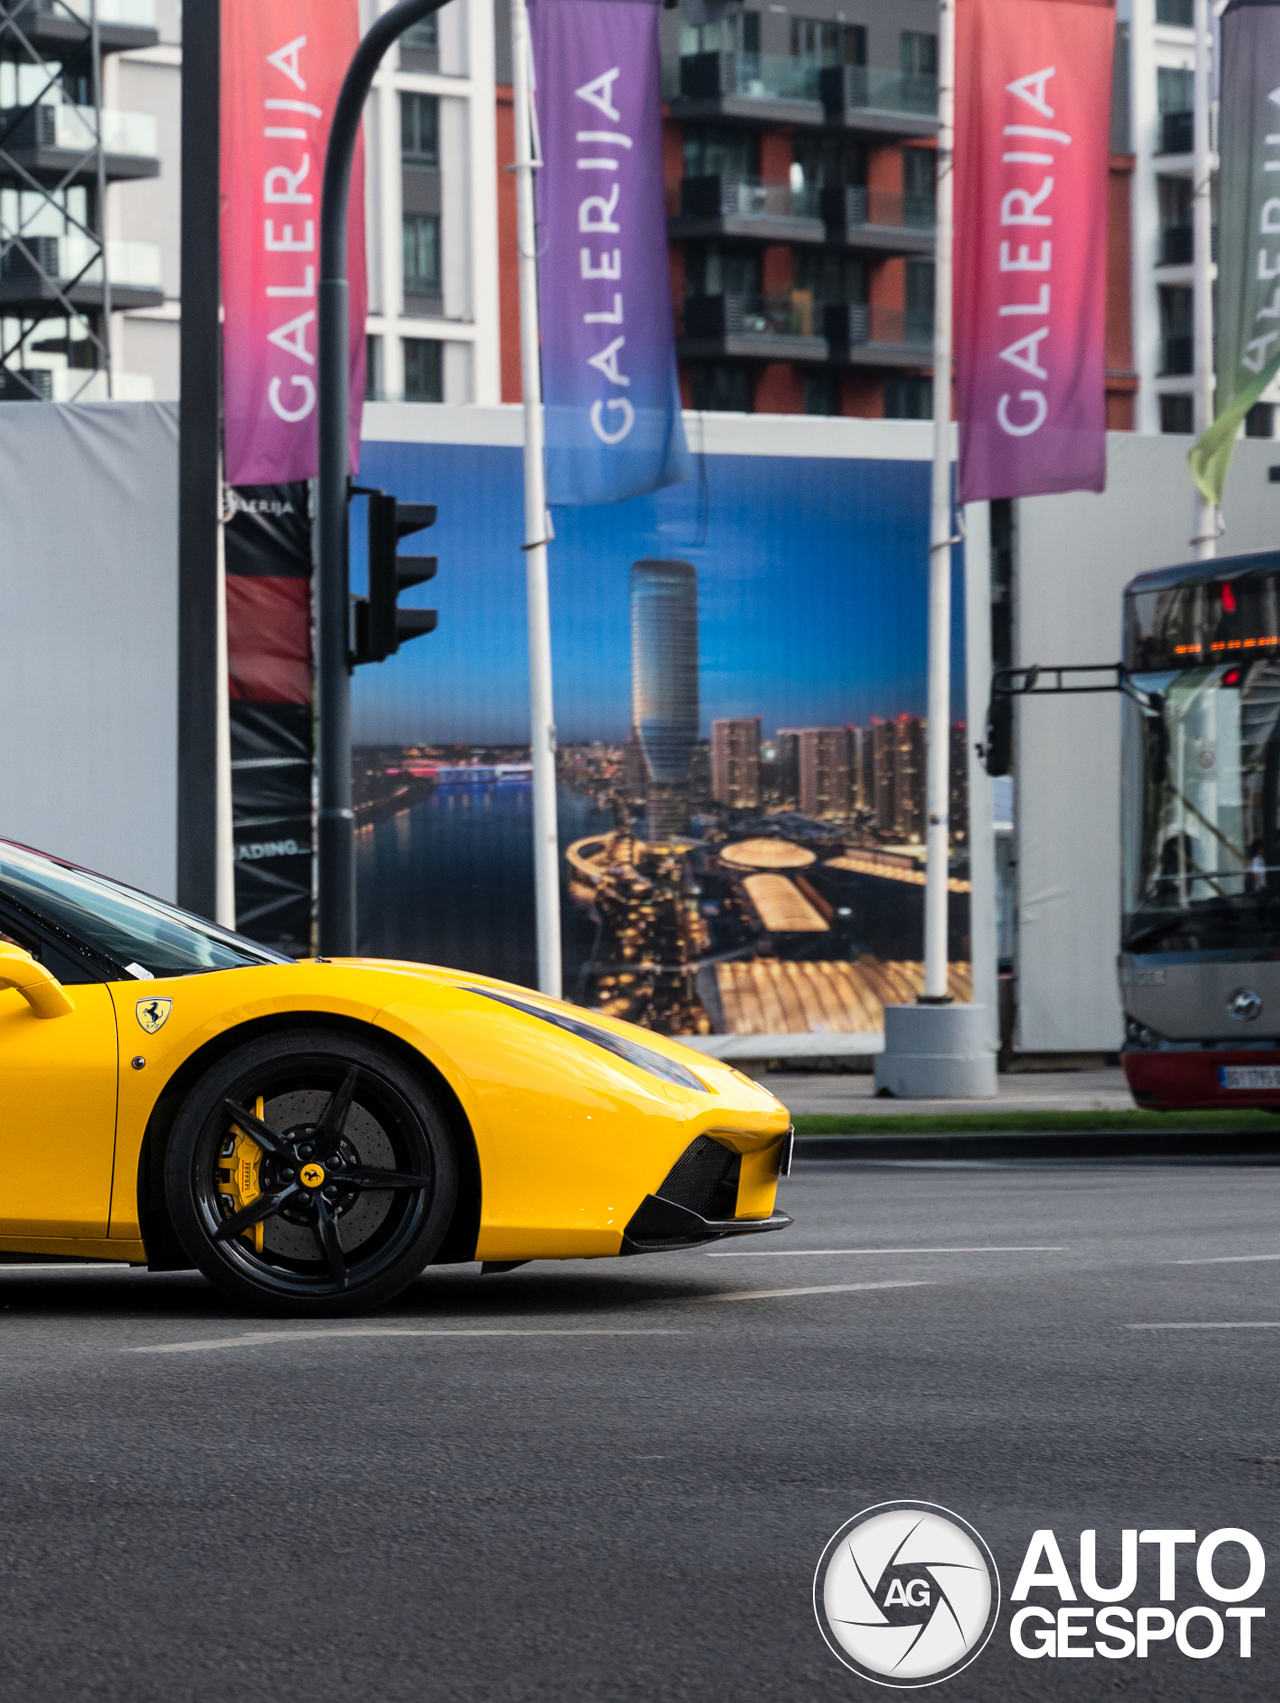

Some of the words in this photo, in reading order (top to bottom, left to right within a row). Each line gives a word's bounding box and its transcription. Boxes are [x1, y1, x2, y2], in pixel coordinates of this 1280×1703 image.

[263, 35, 322, 422] GALERIJA
[575, 66, 635, 445] GALERIJA
[997, 66, 1072, 437] GALERIJA
